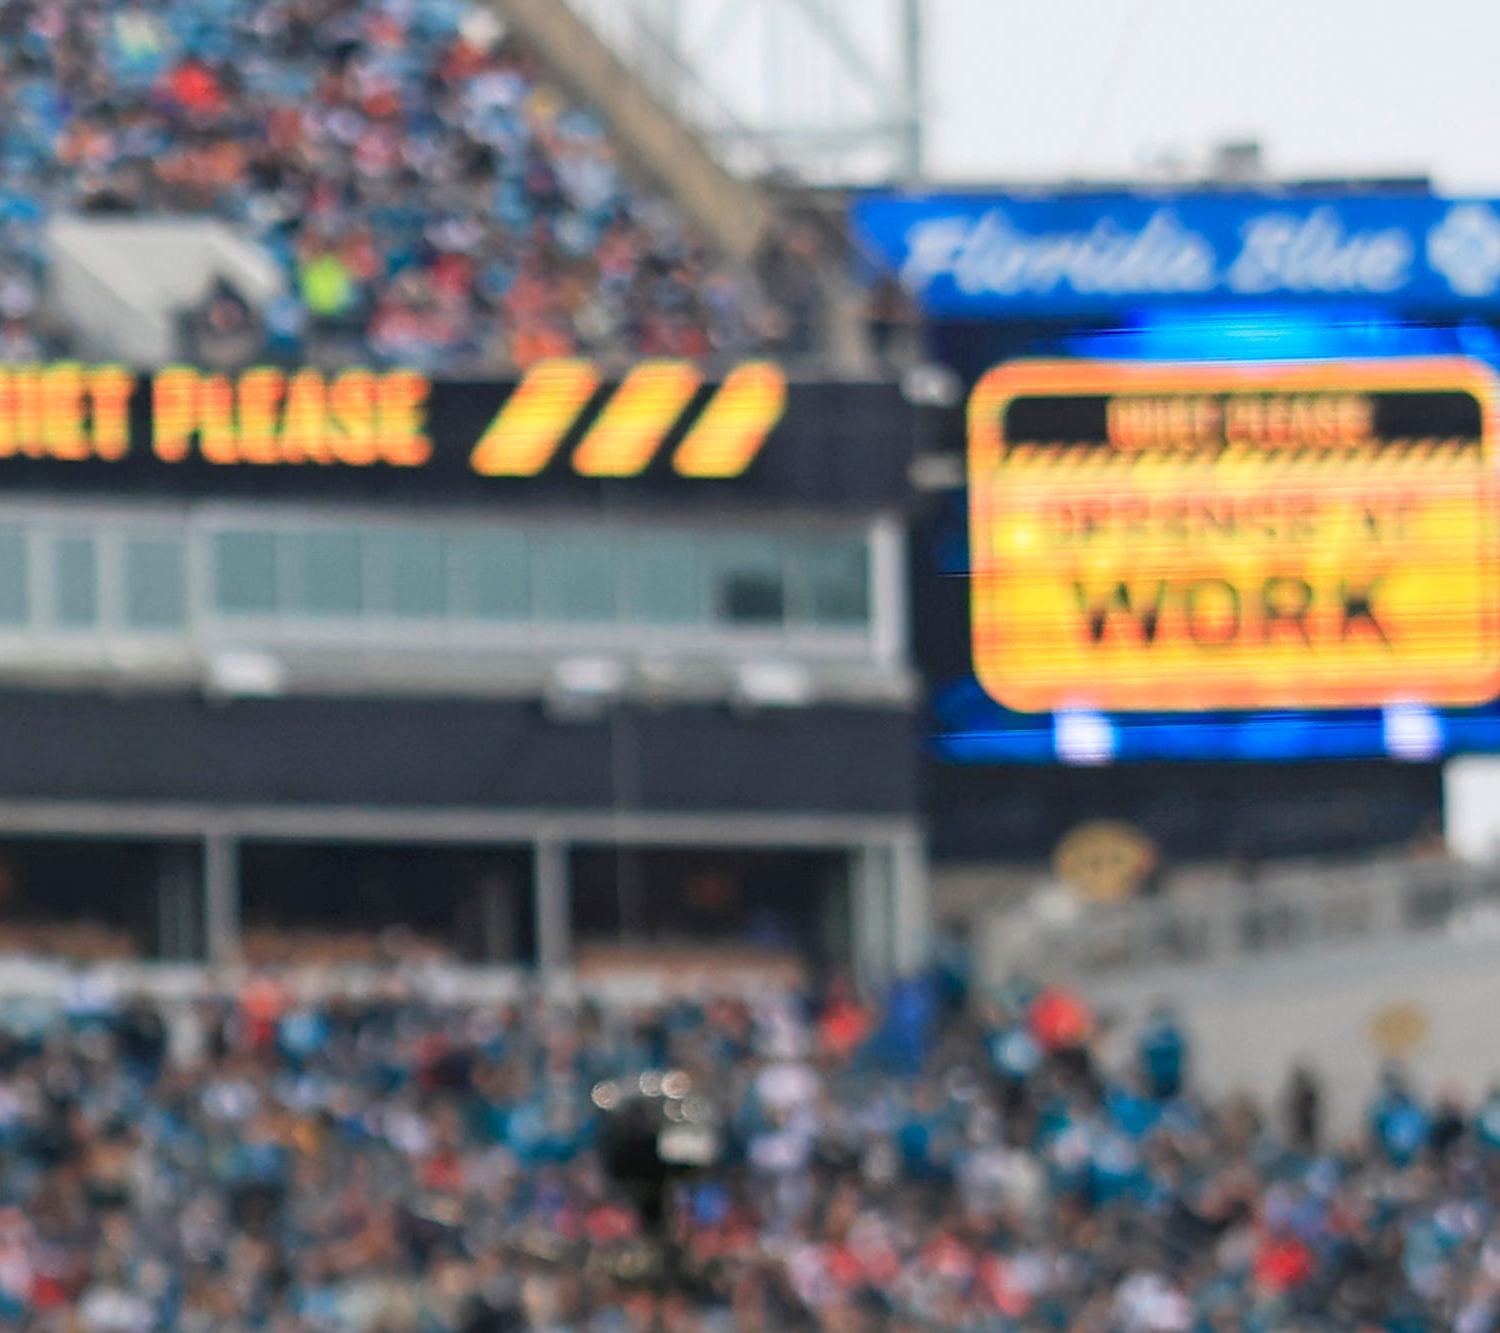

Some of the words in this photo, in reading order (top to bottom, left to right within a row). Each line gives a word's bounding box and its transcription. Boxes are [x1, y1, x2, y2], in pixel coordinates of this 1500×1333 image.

[902, 206, 1217, 294] Florida
[1224, 203, 1414, 294] Blue
[151, 364, 434, 467] PLEASE
[1070, 575, 1398, 655] WORK
